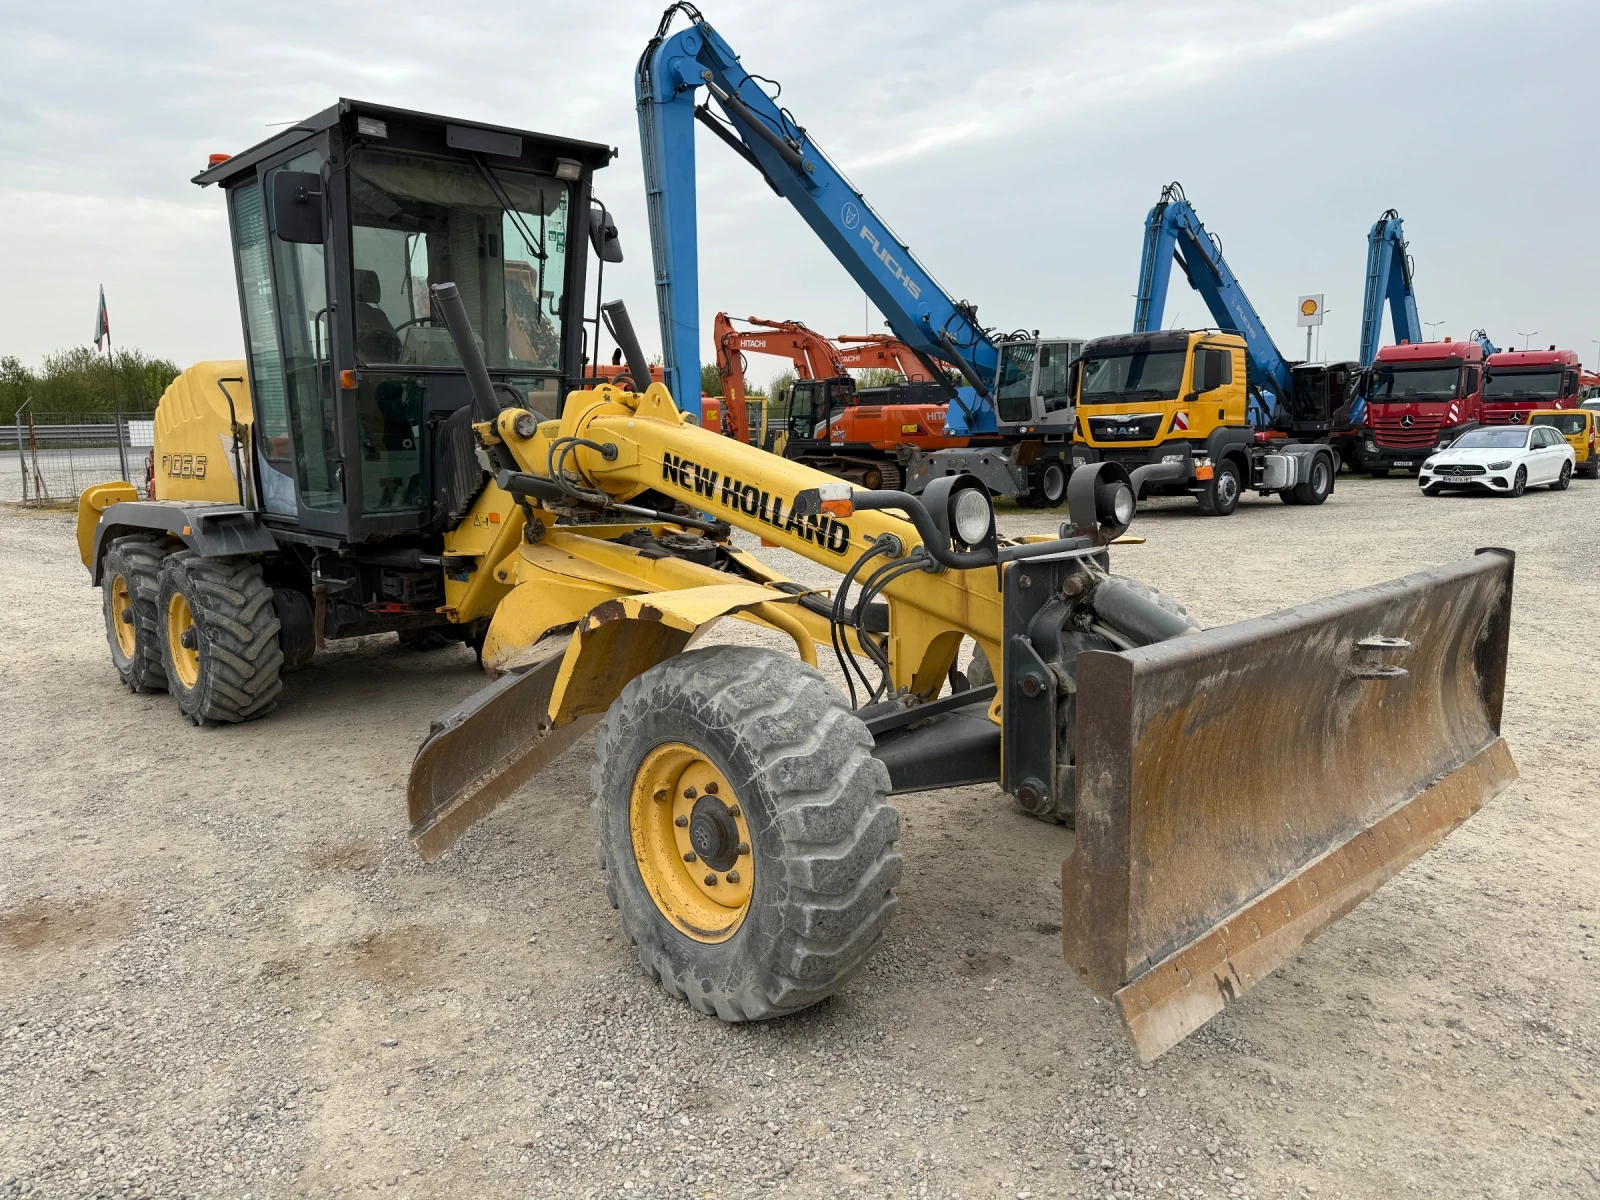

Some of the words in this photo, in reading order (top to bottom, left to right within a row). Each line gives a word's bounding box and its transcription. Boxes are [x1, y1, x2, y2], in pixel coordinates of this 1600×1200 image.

[860, 225, 921, 300] FUCHS
[740, 339, 766, 348] HITACHI
[1106, 426, 1140, 436] MAN
[662, 451, 718, 500] NEW
[721, 475, 850, 557] HOLLAND
